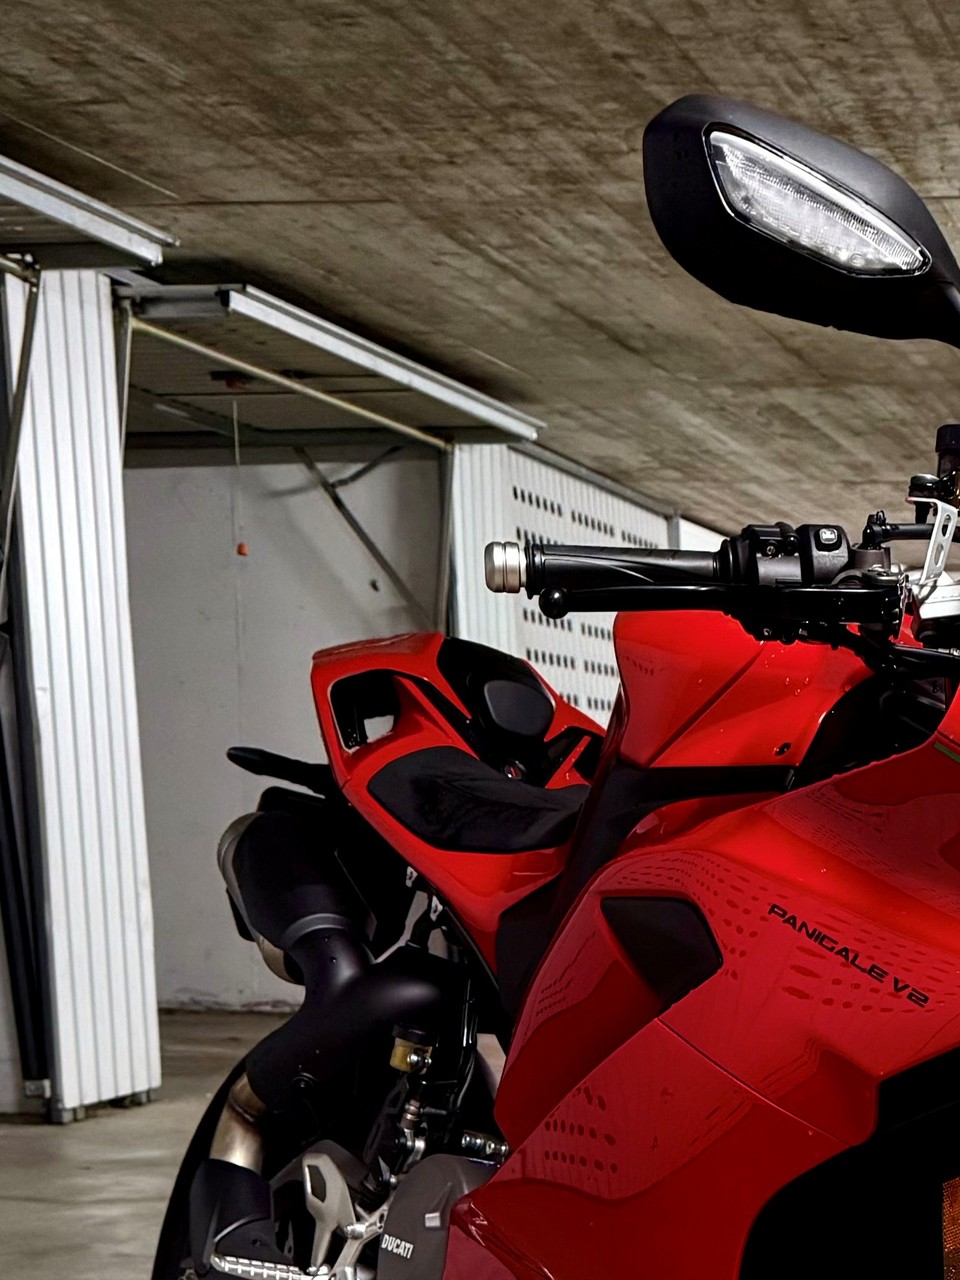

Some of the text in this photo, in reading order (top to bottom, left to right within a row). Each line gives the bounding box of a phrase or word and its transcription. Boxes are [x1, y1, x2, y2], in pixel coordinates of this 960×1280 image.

[768, 903, 930, 1009] PANIGALE V2
[381, 1234, 414, 1258] DUCATI
